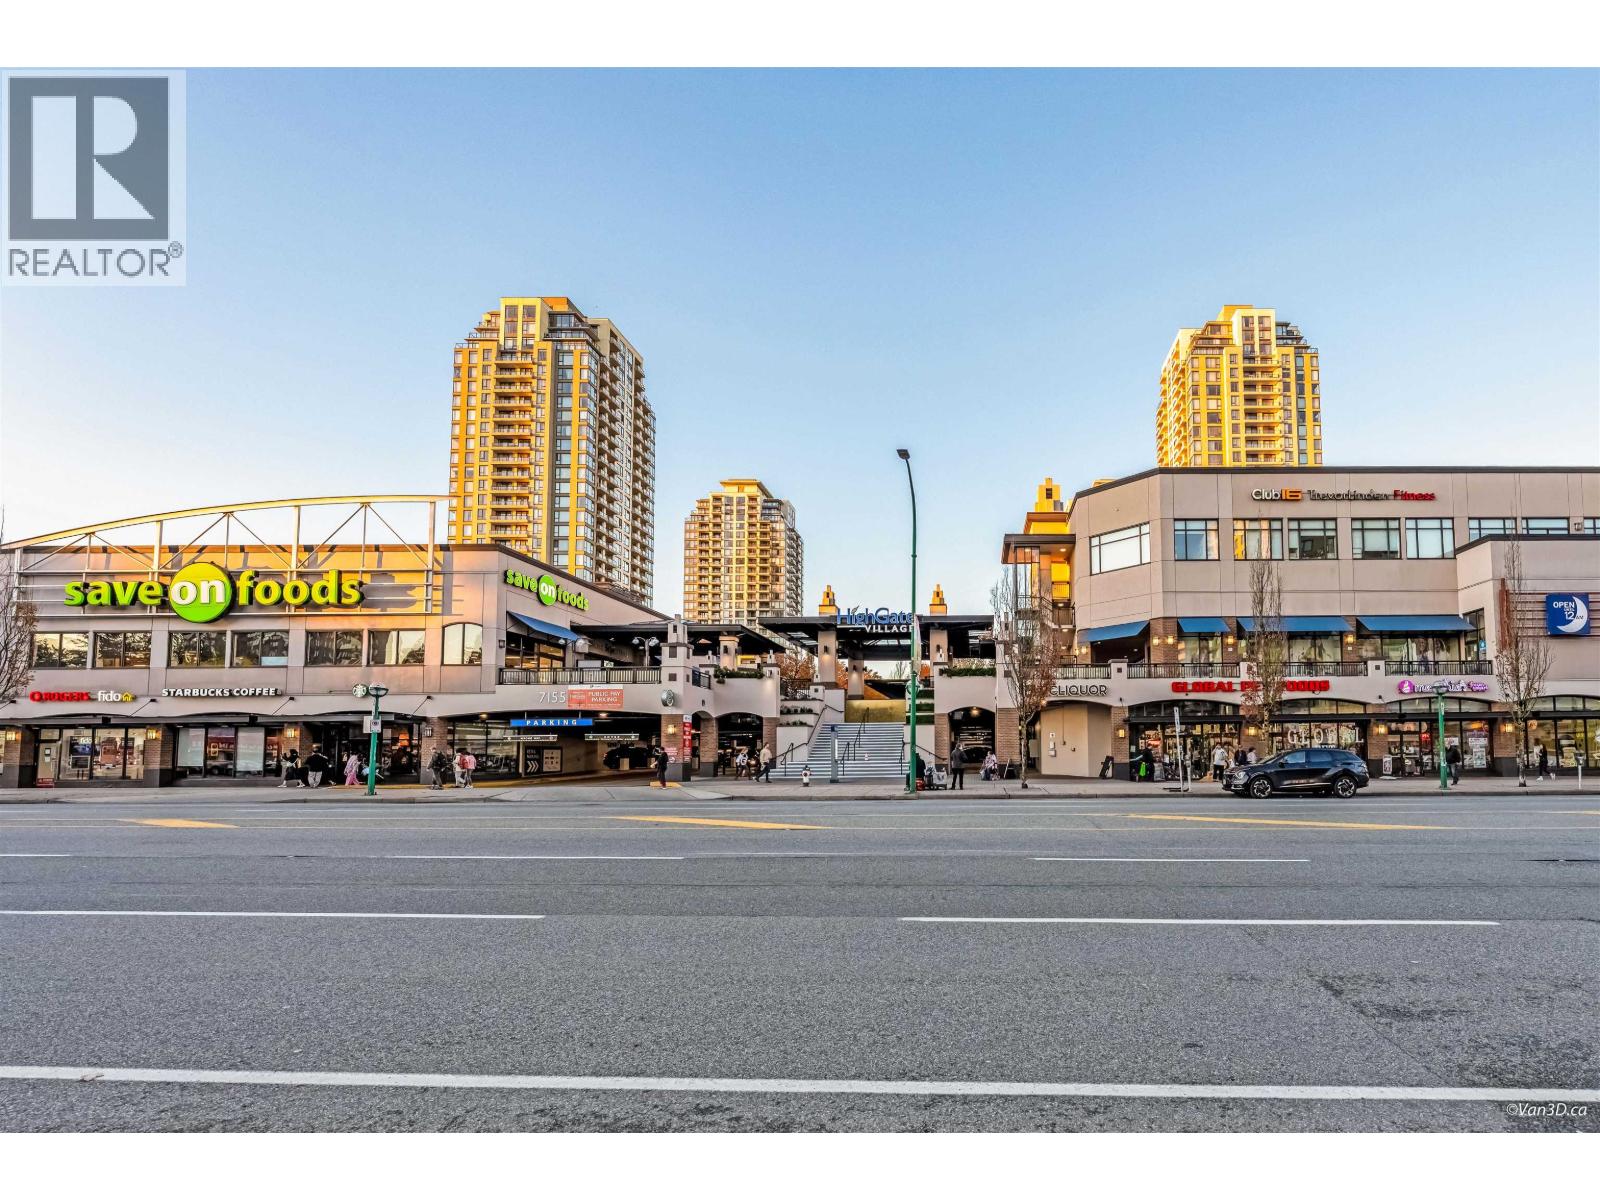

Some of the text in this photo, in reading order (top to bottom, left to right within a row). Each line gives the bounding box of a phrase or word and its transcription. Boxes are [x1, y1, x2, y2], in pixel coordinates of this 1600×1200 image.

[1393, 489, 1437, 501] Fitness
[1553, 601, 1575, 609] OPEN
[836, 607, 914, 626] HighGate
[1564, 611, 1575, 620] 12
[161, 687, 277, 697] STARBUCKS COFFEE
[1058, 685, 1108, 696] LIQUOR
[1171, 681, 1237, 693] GLOBAL
[98, 690, 121, 702] fido
[538, 691, 567, 704] 7155
[526, 719, 578, 727] PARKING
